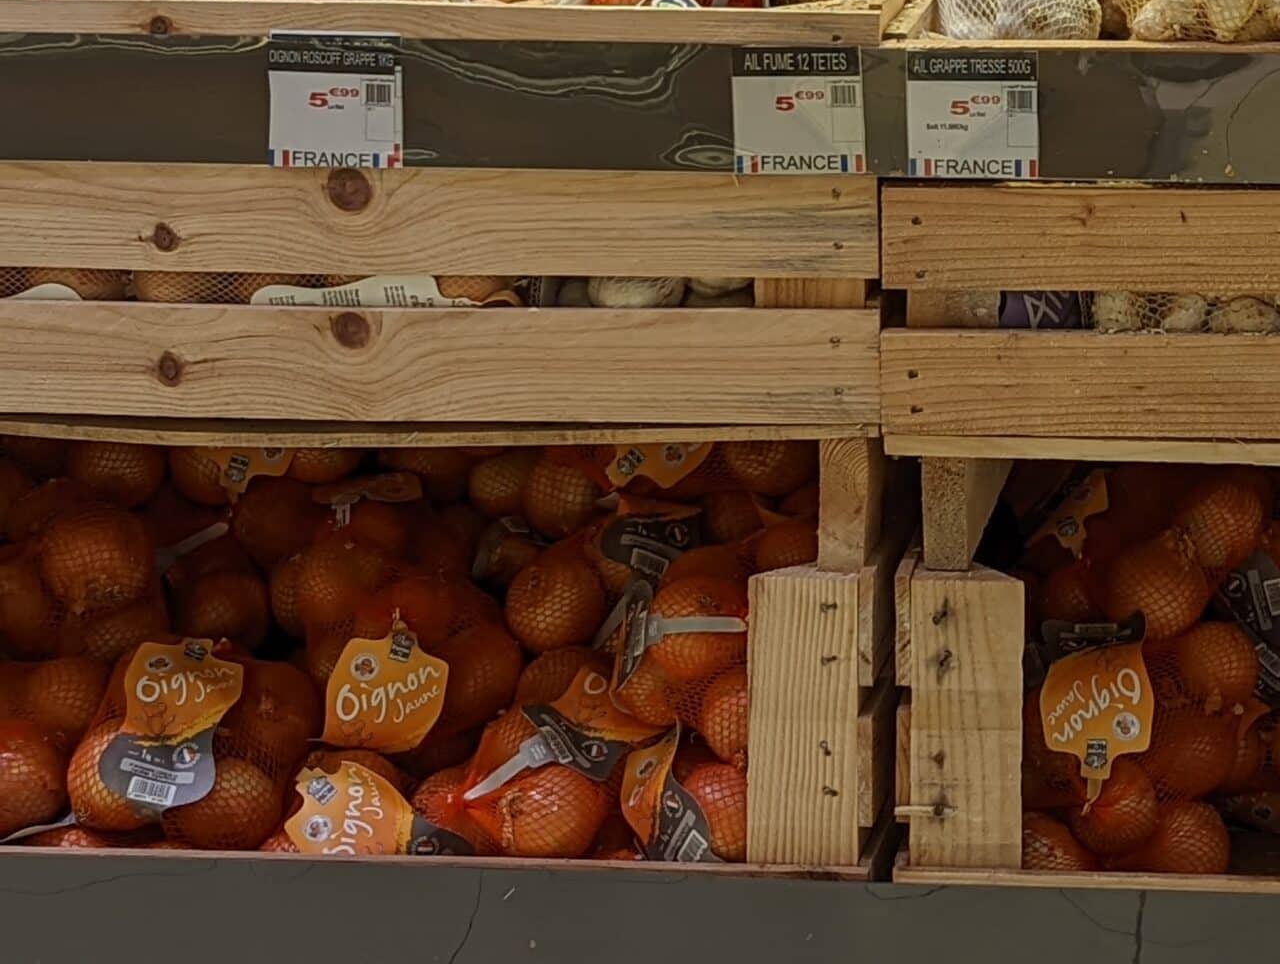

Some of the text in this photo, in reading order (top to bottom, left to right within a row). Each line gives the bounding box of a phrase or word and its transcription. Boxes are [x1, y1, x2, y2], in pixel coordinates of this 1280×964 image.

[268, 50, 394, 67] OIGNON ROSCOFF GRAPPE 1KG
[744, 53, 847, 71] AIL FUME 12 TETES
[913, 58, 1031, 74] AIL GRAPPE TRESSE 500G
[292, 150, 370, 167] FRANCE
[761, 155, 839, 171] FRANCE
[934, 159, 1013, 175] FRANCE
[136, 667, 235, 706] Oignon
[336, 664, 440, 724] Oignon
[392, 685, 440, 723] Jaune
[1047, 680, 1085, 725] Jaune
[1052, 668, 1141, 743] Oignon
